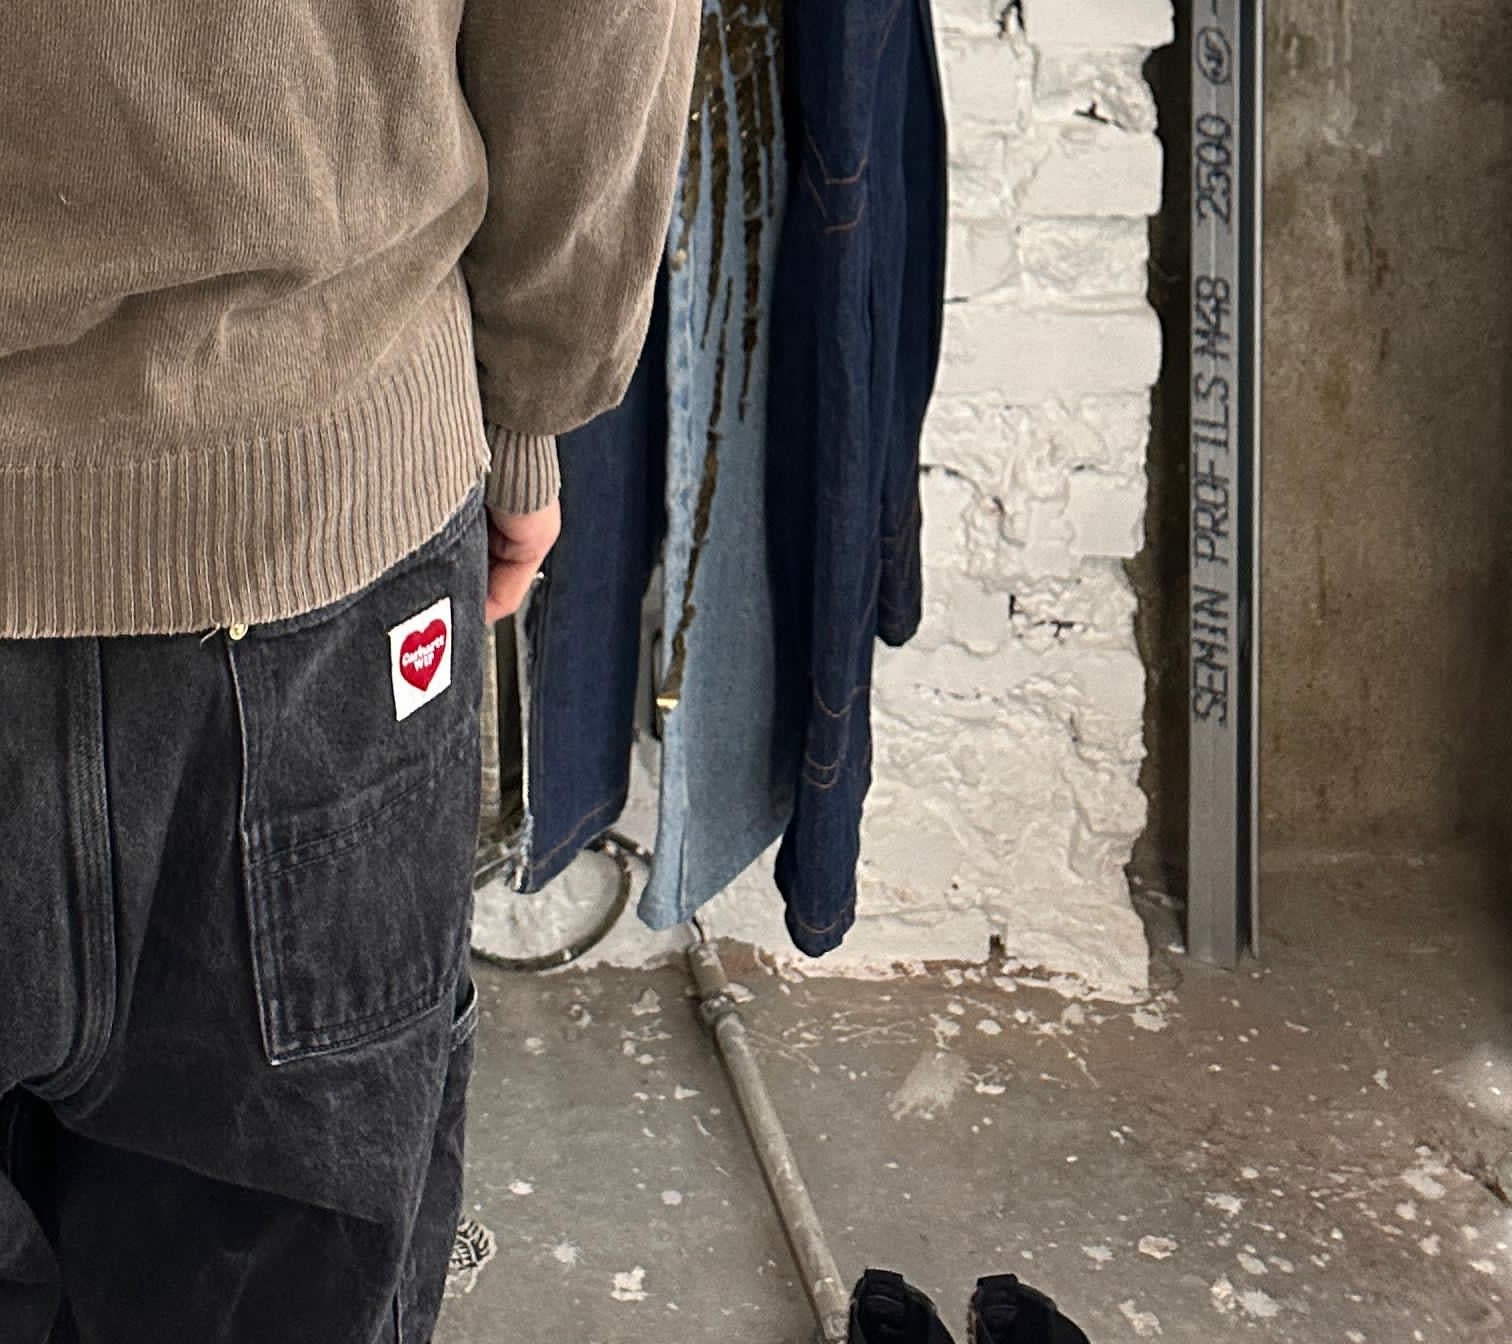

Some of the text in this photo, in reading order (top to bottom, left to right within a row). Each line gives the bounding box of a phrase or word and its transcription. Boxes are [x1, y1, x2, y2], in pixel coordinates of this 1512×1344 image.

[1194, 113, 1232, 228] 2500
[1194, 276, 1231, 361] M48
[1191, 371, 1229, 569] PROFILS
[1191, 585, 1228, 726] SEMIN
